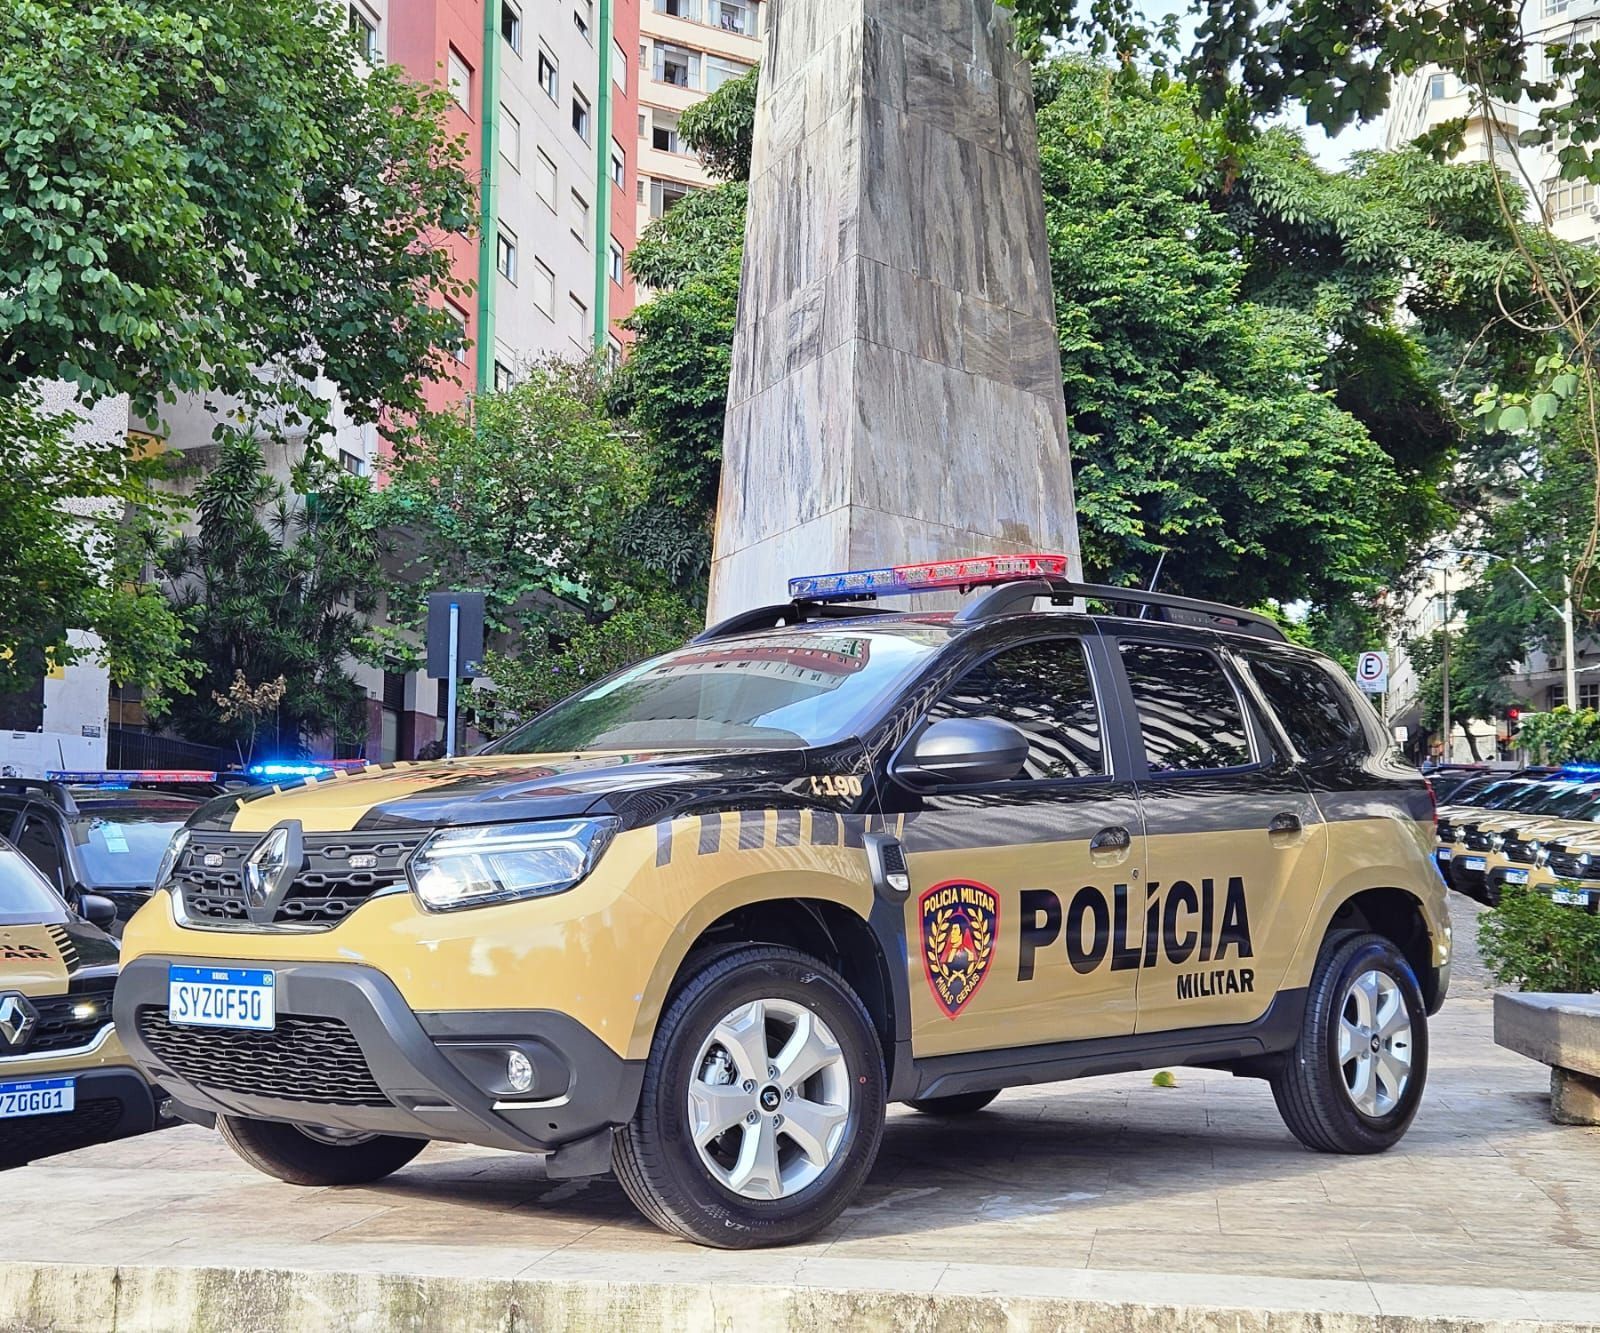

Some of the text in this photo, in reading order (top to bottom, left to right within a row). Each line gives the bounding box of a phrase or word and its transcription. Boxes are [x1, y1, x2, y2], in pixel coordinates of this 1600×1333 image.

[1364, 657, 1375, 675] E
[822, 775, 863, 796] 190
[960, 887, 995, 914] MILITAR
[1017, 876, 1255, 982] POLÍCIA
[936, 972, 981, 1005] MINAS GERAIS
[1177, 968, 1255, 1000] MILITAR
